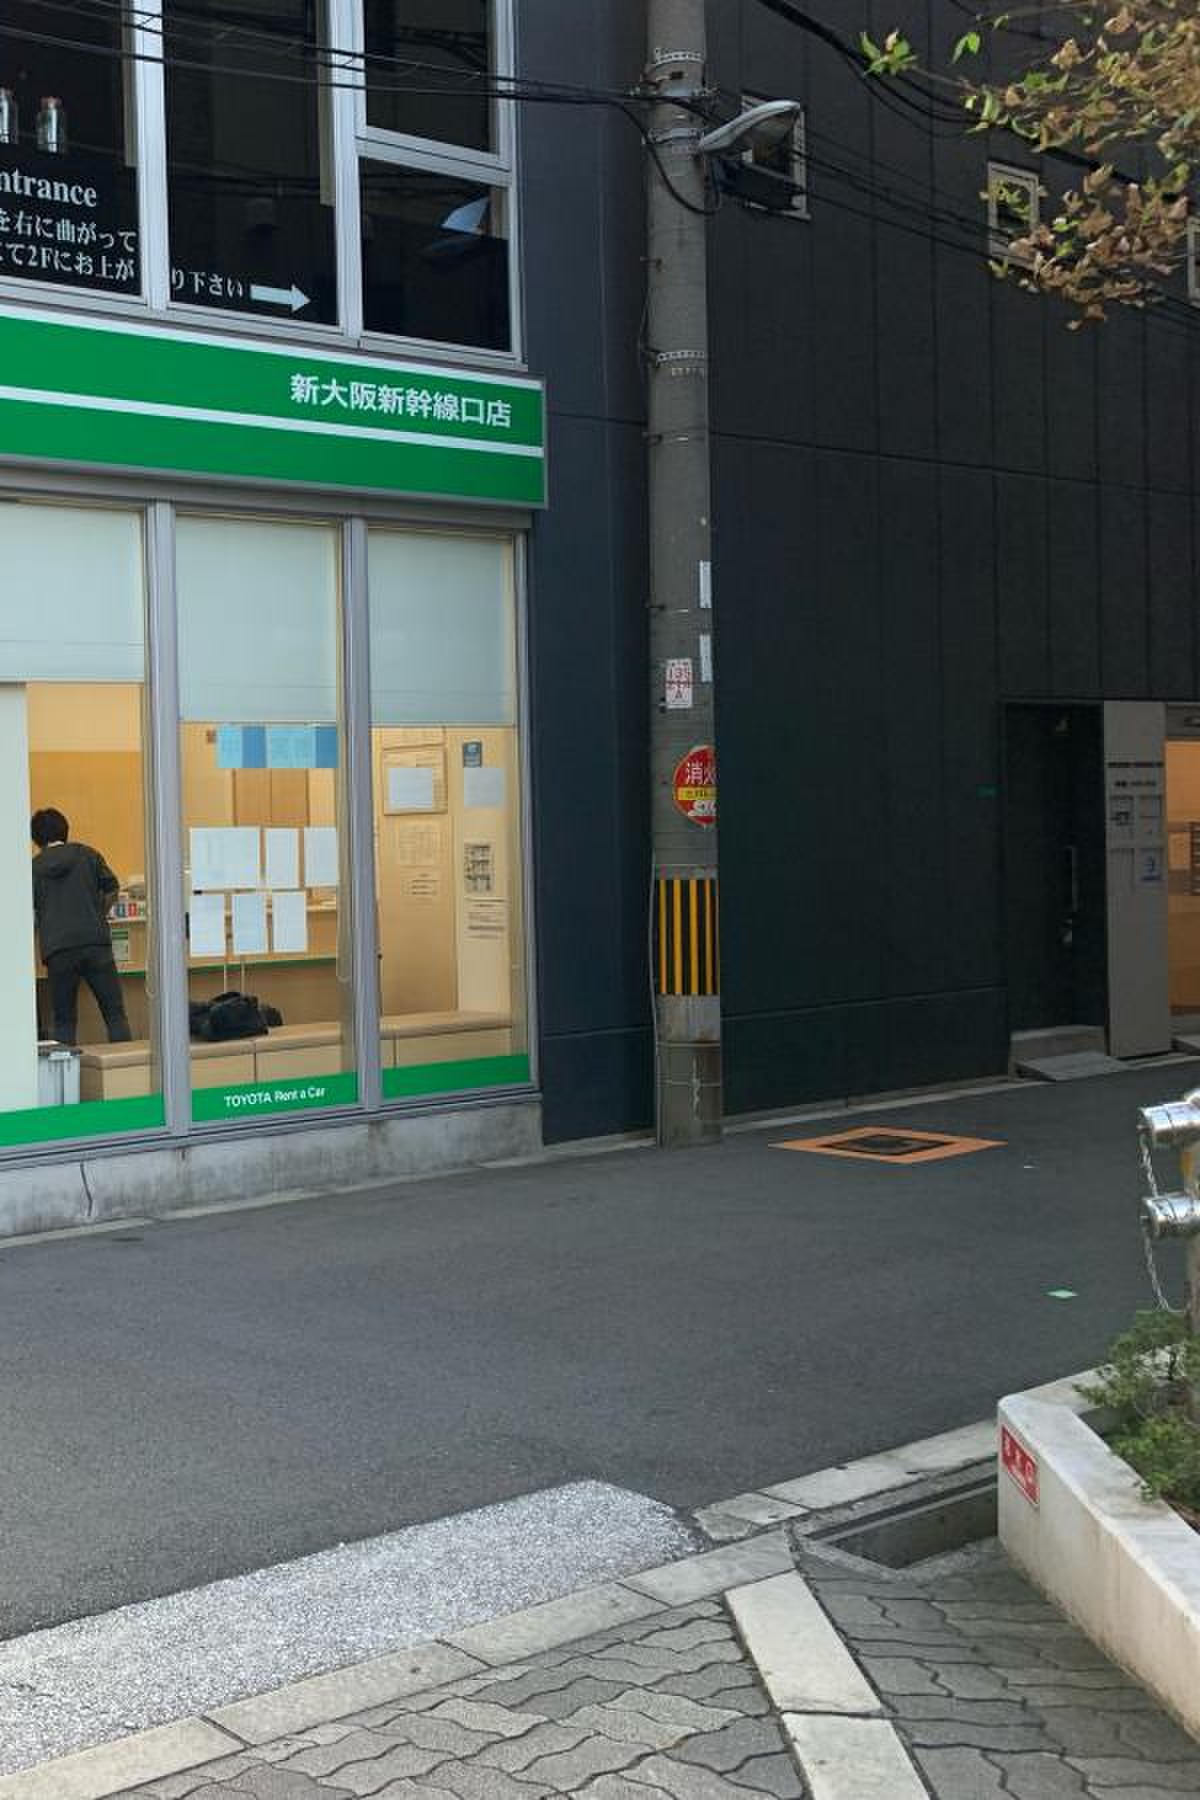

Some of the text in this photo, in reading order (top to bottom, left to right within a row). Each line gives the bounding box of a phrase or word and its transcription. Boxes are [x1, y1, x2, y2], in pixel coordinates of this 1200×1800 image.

[172, 267, 244, 298] り下さい
[290, 373, 513, 428] 新大阪新幹線口店
[224, 1092, 272, 1107] TOYOTA
